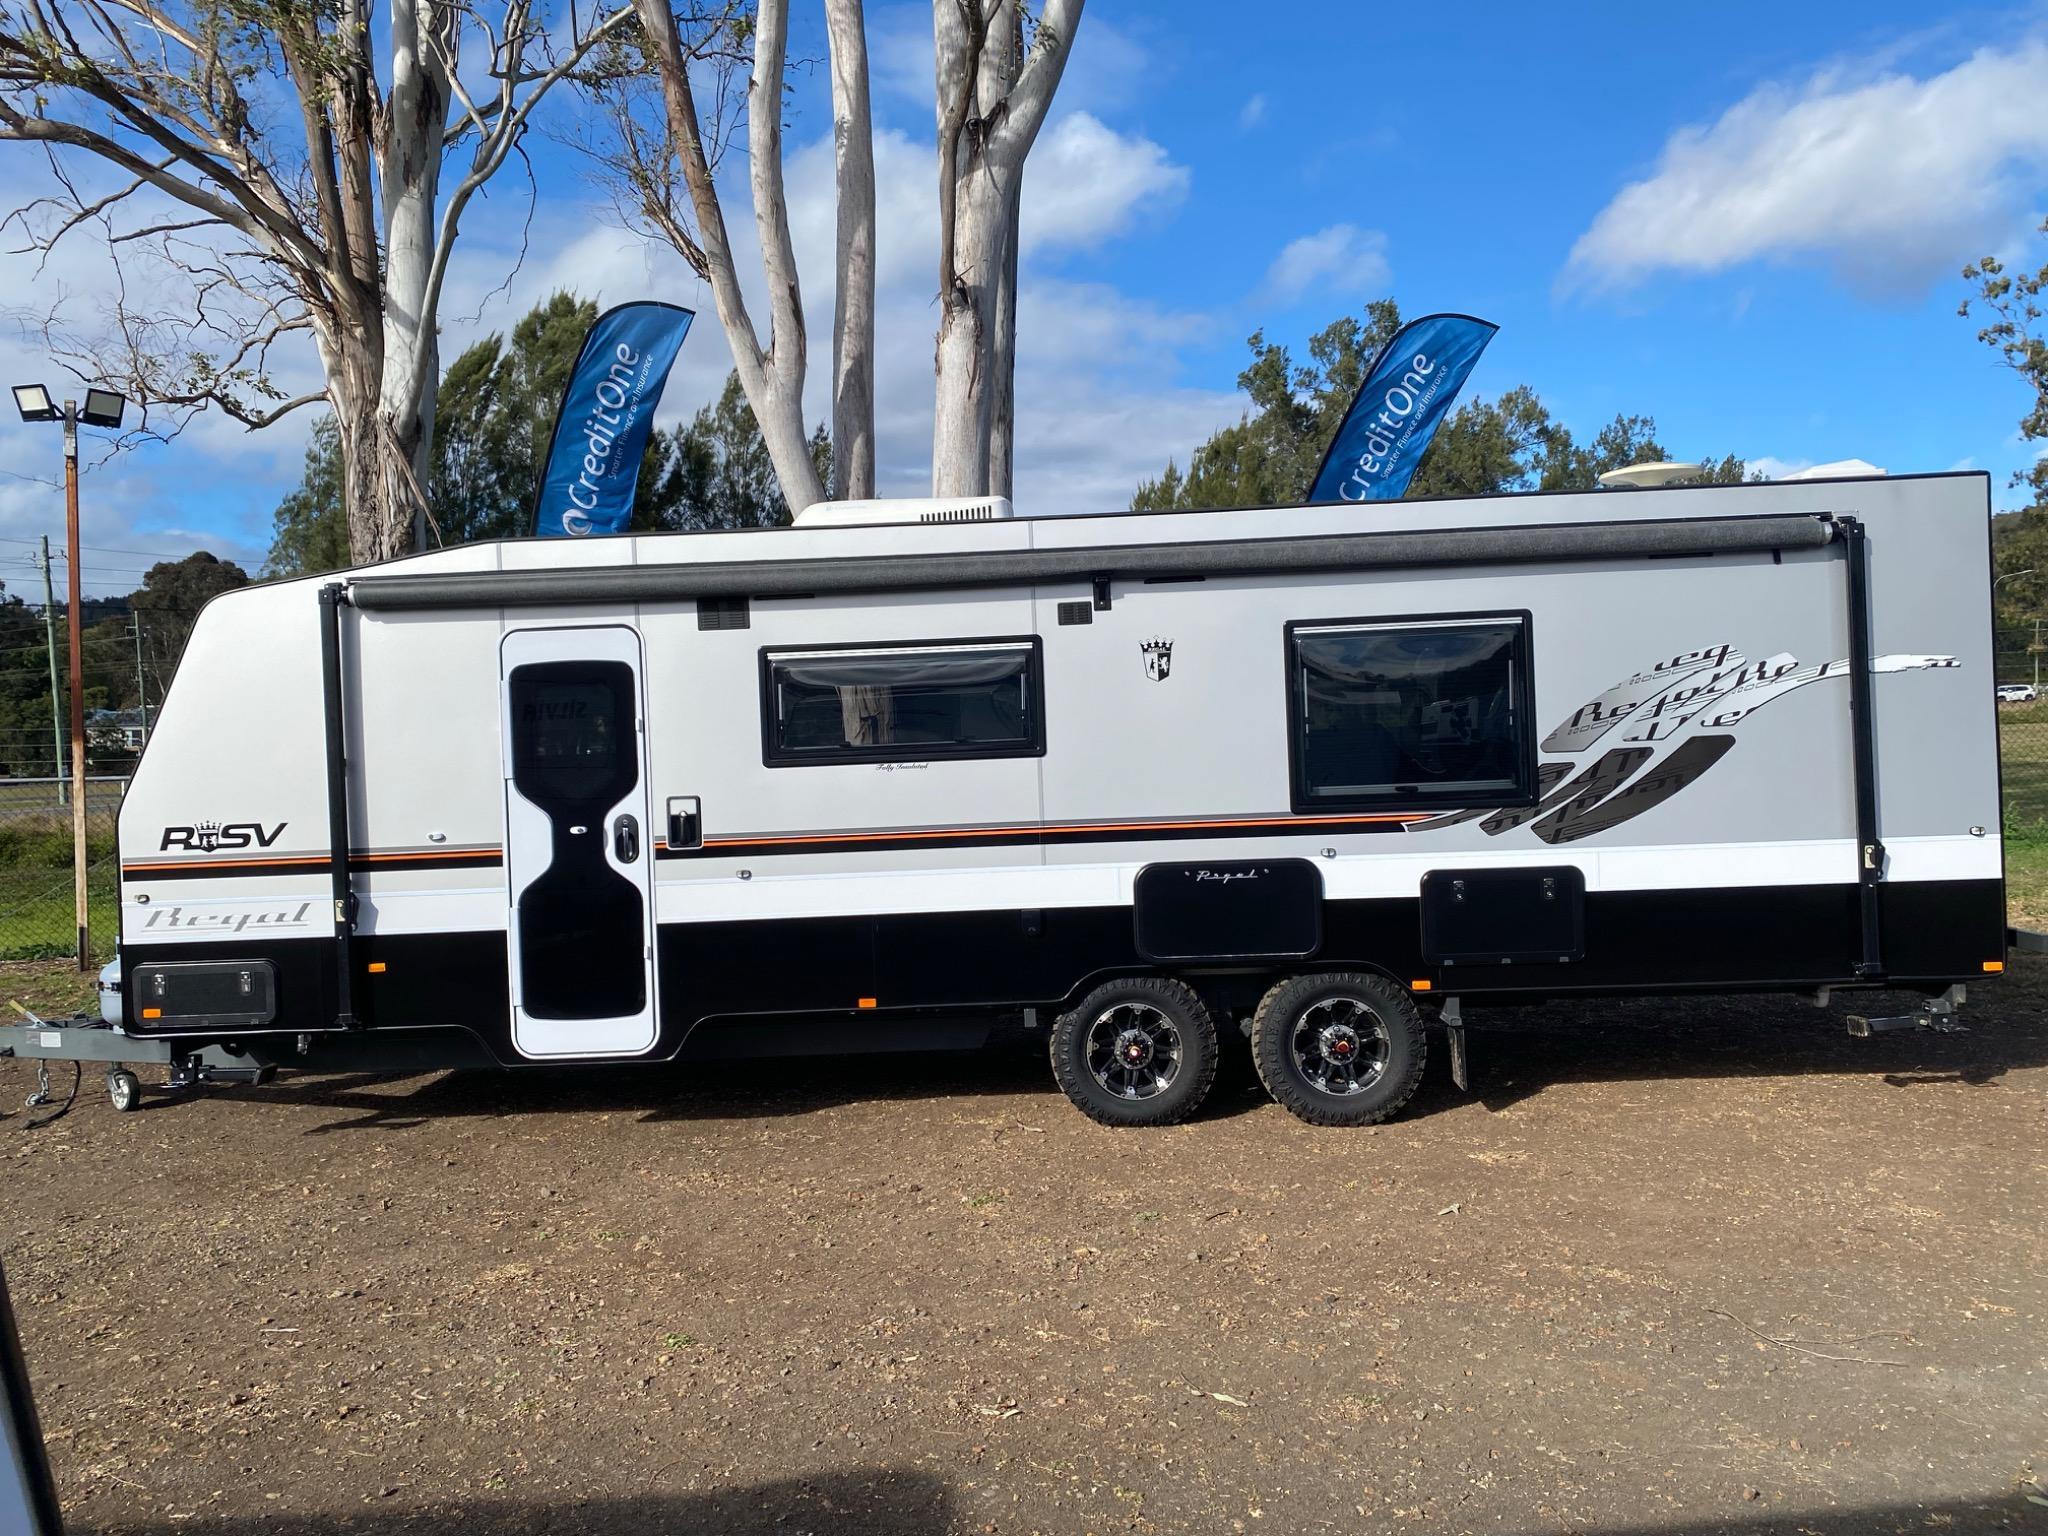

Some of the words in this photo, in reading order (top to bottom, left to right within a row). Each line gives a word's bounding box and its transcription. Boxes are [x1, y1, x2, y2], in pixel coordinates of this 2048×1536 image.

[634, 354, 654, 398] Insurance
[1423, 365, 1448, 405] Insurance
[1196, 868, 1259, 884] Regal
[141, 902, 312, 933] Regal
